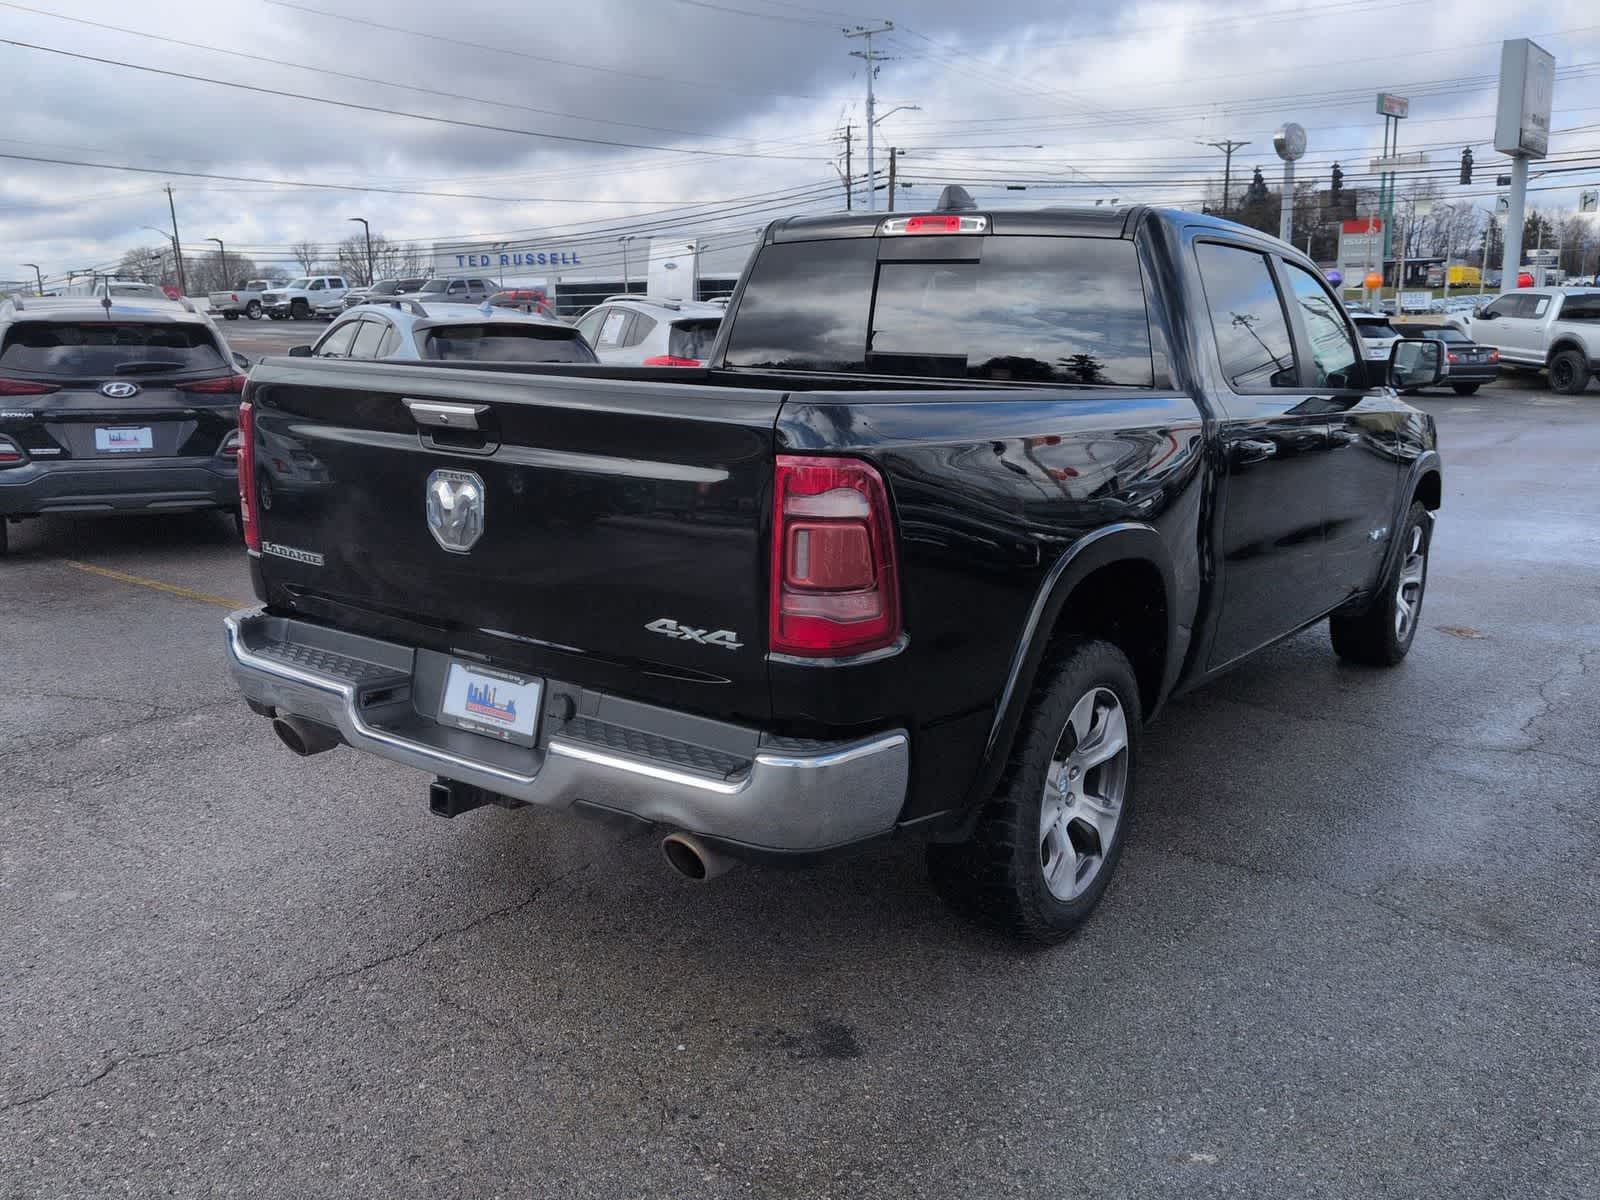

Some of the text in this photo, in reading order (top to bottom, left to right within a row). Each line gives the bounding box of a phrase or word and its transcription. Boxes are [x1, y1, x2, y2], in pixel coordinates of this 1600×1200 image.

[456, 252, 582, 267] TED RUSSELL
[262, 541, 325, 566] LARAMIE
